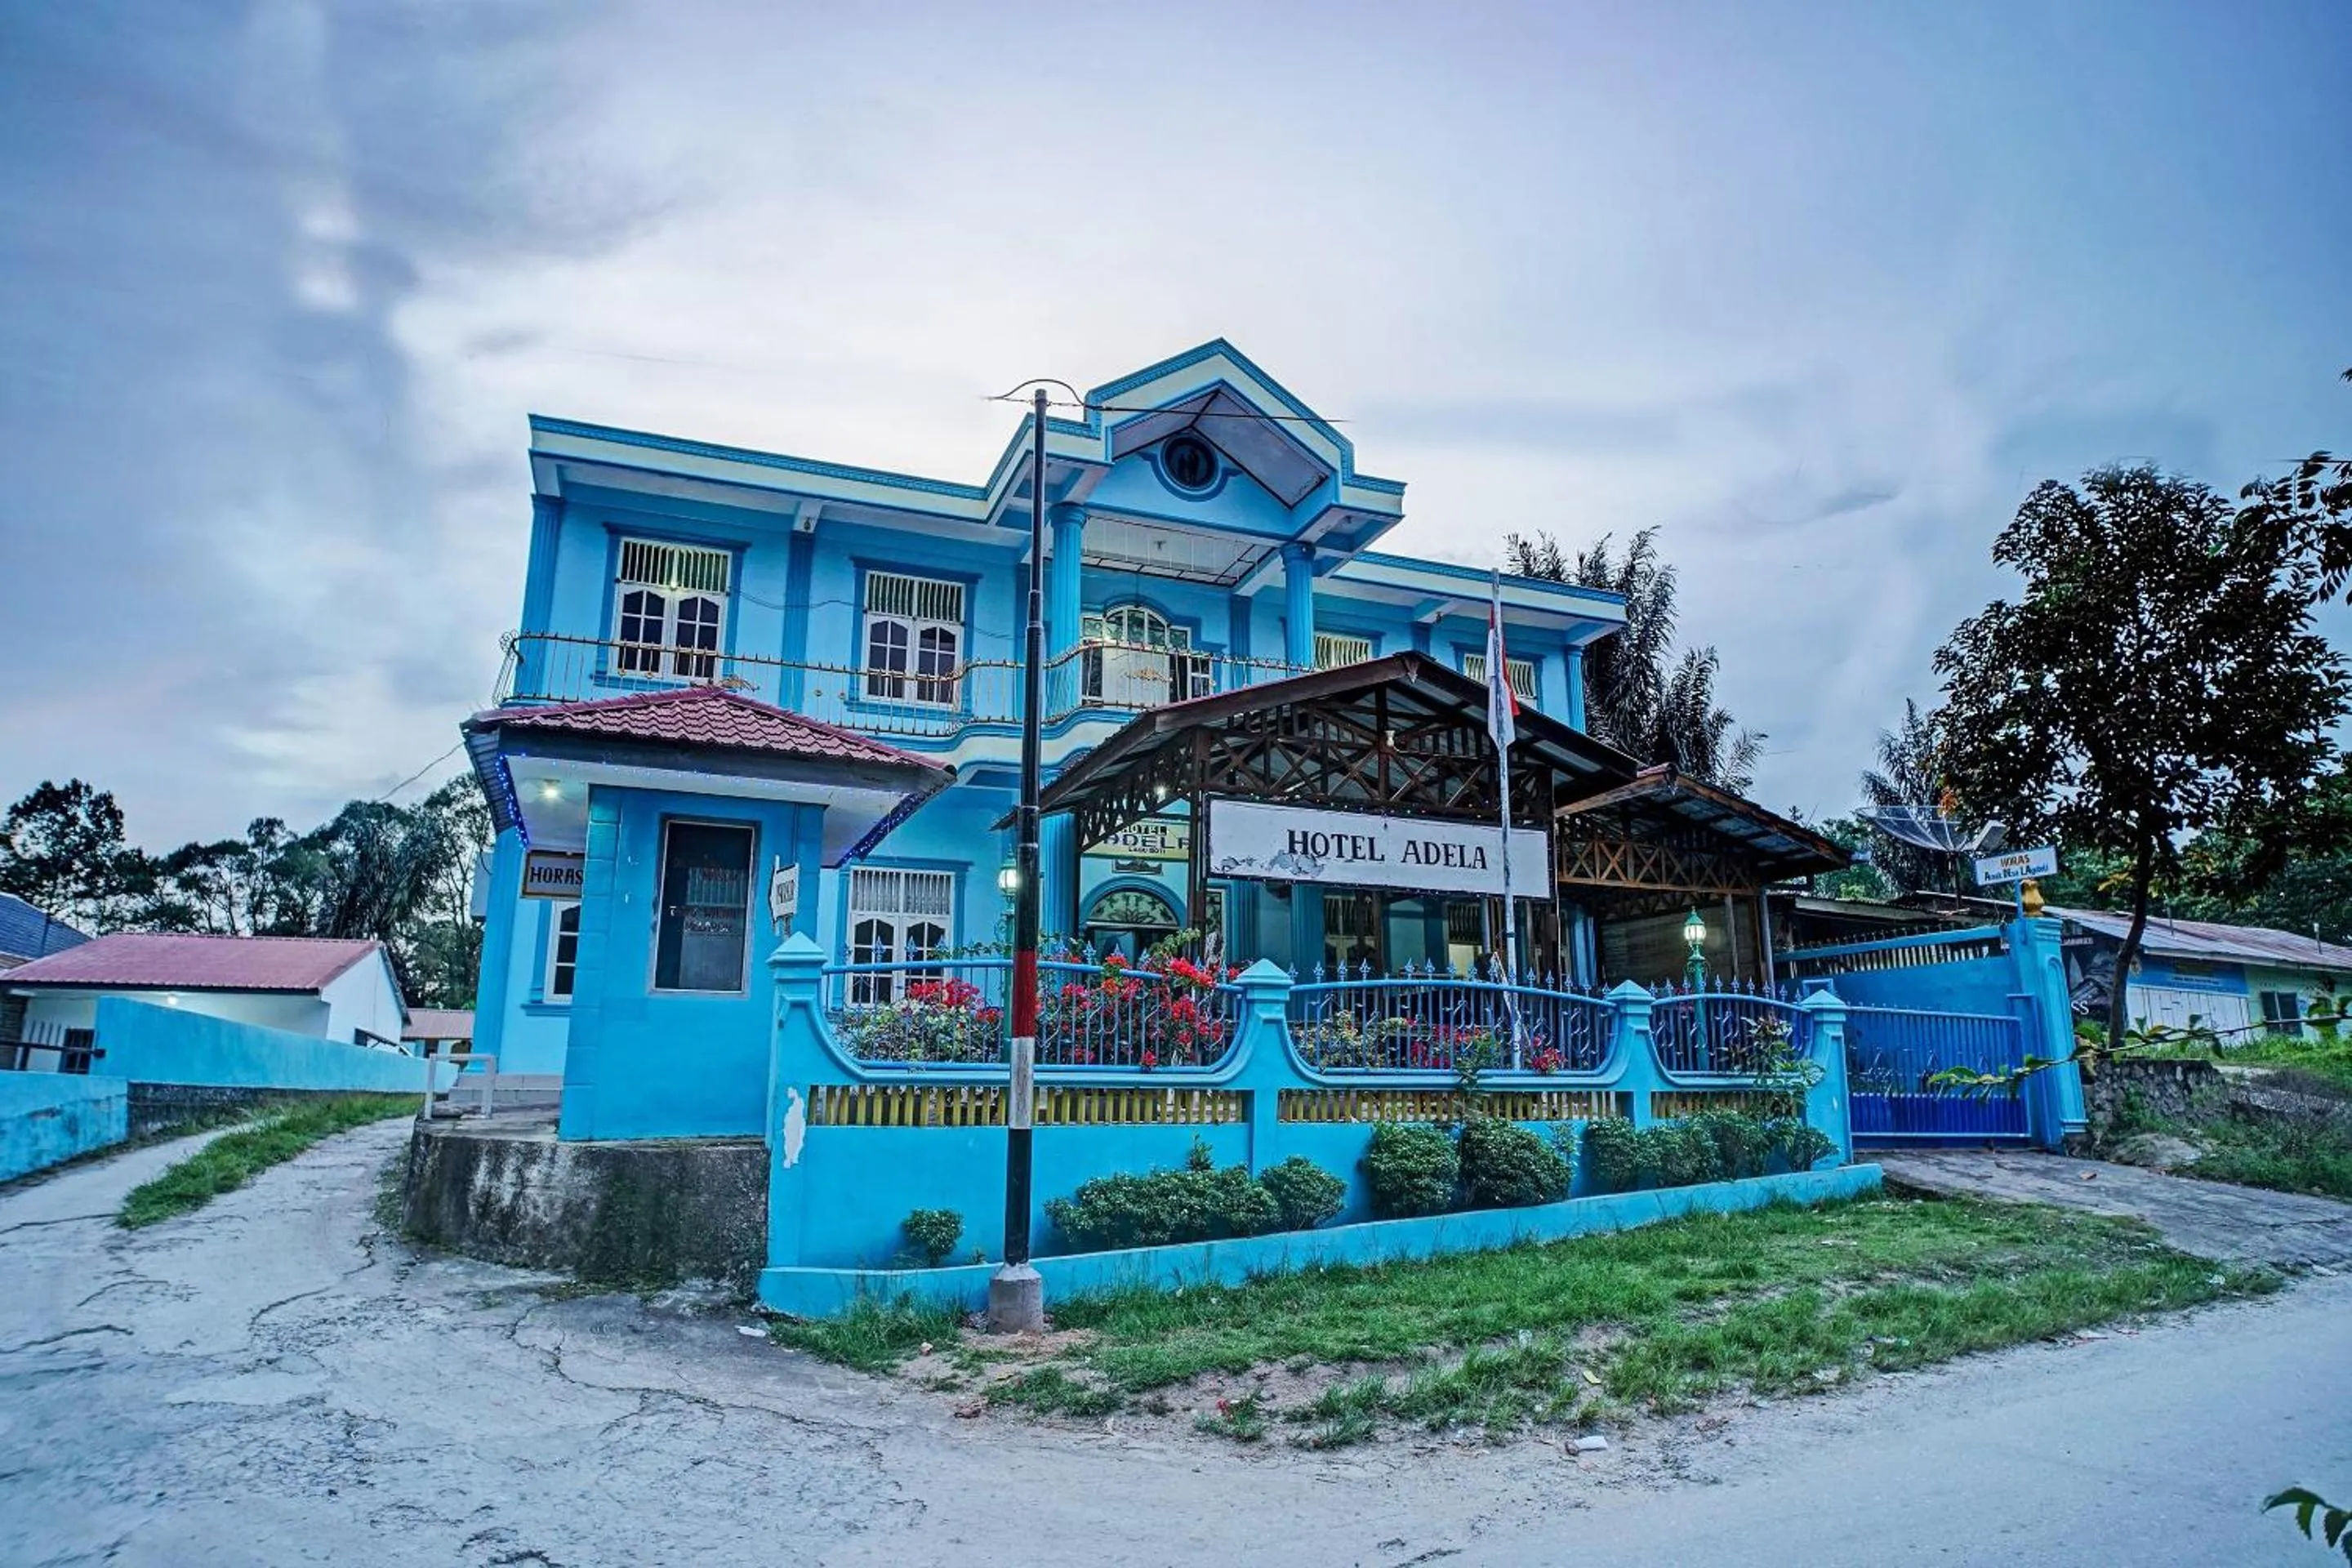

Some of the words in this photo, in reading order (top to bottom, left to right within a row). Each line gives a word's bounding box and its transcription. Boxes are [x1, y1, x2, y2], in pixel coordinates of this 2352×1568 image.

[1287, 829, 1385, 862] HOTEL
[1401, 840, 1488, 870] ADELA
[529, 866, 584, 884] HORAS
